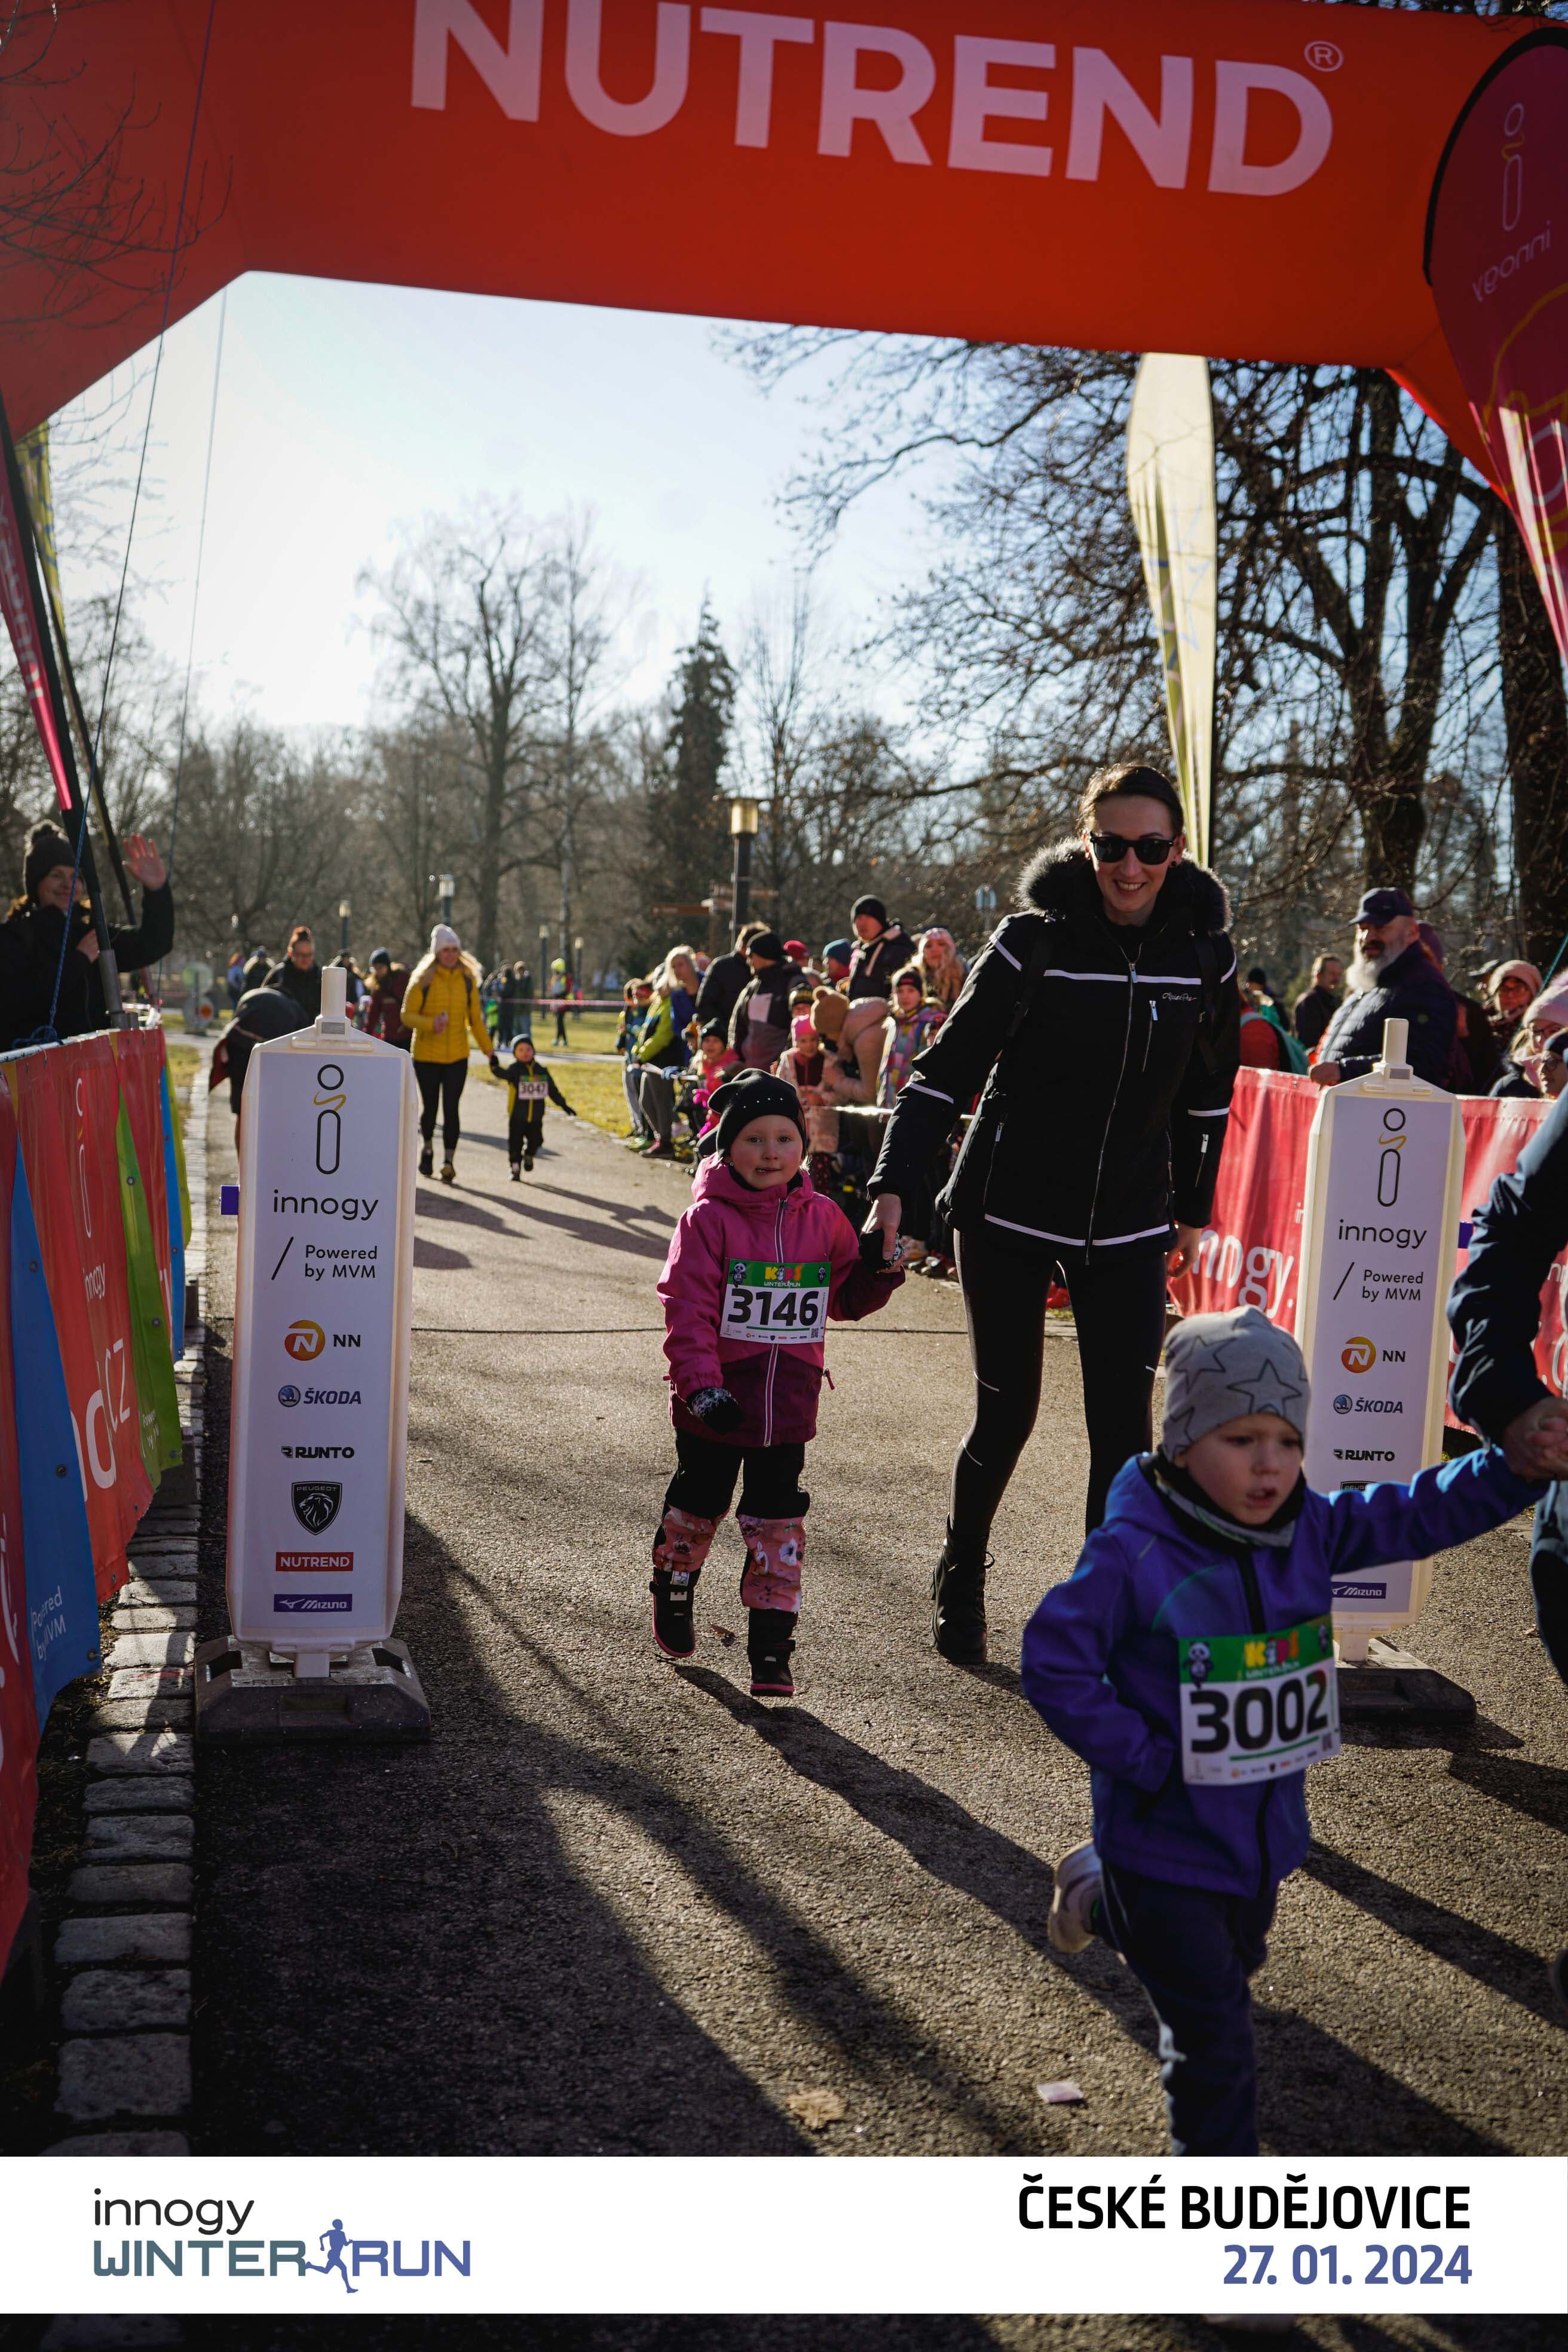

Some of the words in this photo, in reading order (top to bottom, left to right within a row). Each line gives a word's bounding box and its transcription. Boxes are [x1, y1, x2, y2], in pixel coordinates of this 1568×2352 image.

[411, 0, 1333, 196] NUTREND
[273, 1189, 379, 1221] innogy
[1339, 1219, 1427, 1249] innogy
[305, 1245, 377, 1259] Powered
[305, 1263, 325, 1281] by
[332, 1264, 375, 1278] MVM
[1364, 1269, 1424, 1284] Powered
[1362, 1286, 1379, 1303] by
[1385, 1287, 1420, 1301] MVM
[727, 1288, 819, 1327] 3146
[333, 1334, 361, 1348] NN
[1382, 1350, 1406, 1362] NN
[304, 1388, 362, 1404] ŠKODA
[1354, 1397, 1403, 1414] ŠKODA
[295, 1446, 355, 1459] RUNTO
[1345, 1450, 1395, 1462] RUNTO
[280, 1557, 350, 1567] NUTREND
[1189, 1669, 1328, 1754] 3002
